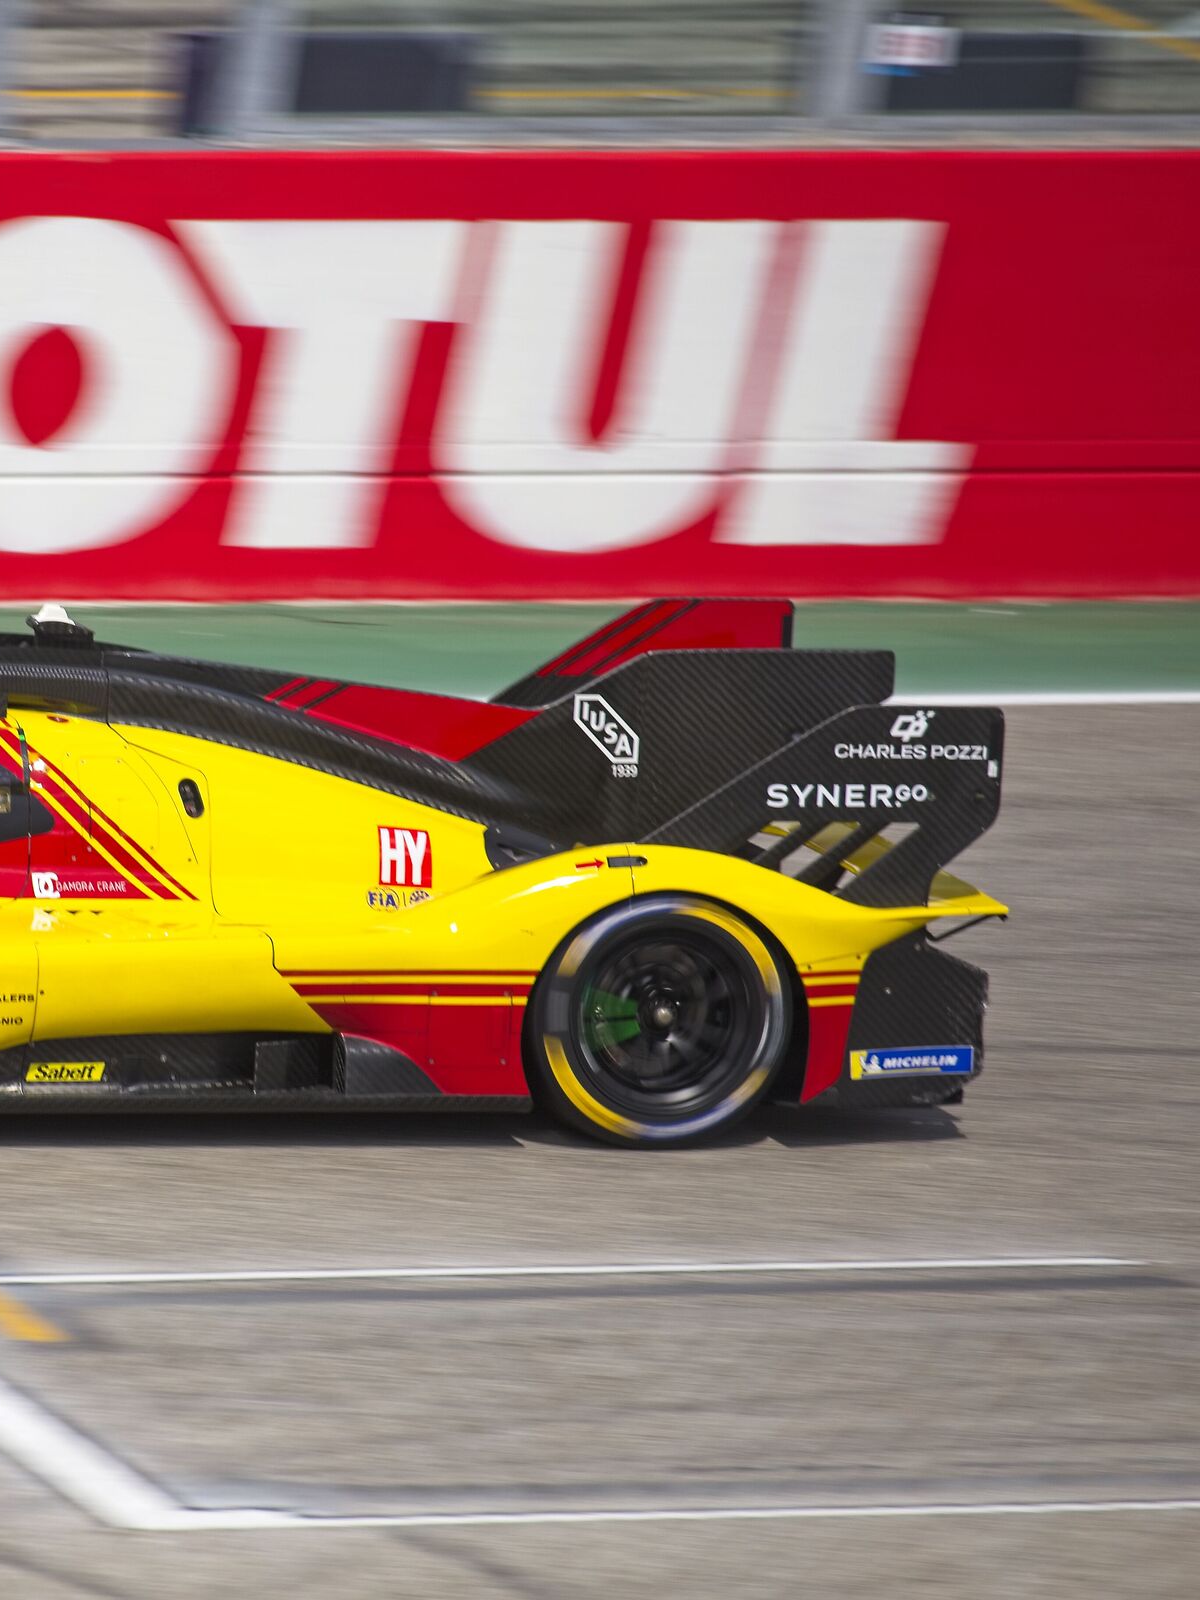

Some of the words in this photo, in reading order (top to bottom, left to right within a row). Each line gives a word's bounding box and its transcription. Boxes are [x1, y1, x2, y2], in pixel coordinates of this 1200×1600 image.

[582, 701, 633, 756] IUSA
[833, 743, 927, 761] CHARLES
[930, 744, 988, 761] POZZI
[611, 764, 639, 778] 1939
[379, 827, 428, 885] HY
[96, 880, 127, 893] CRANE
[882, 1054, 959, 1069] MICHELIN
